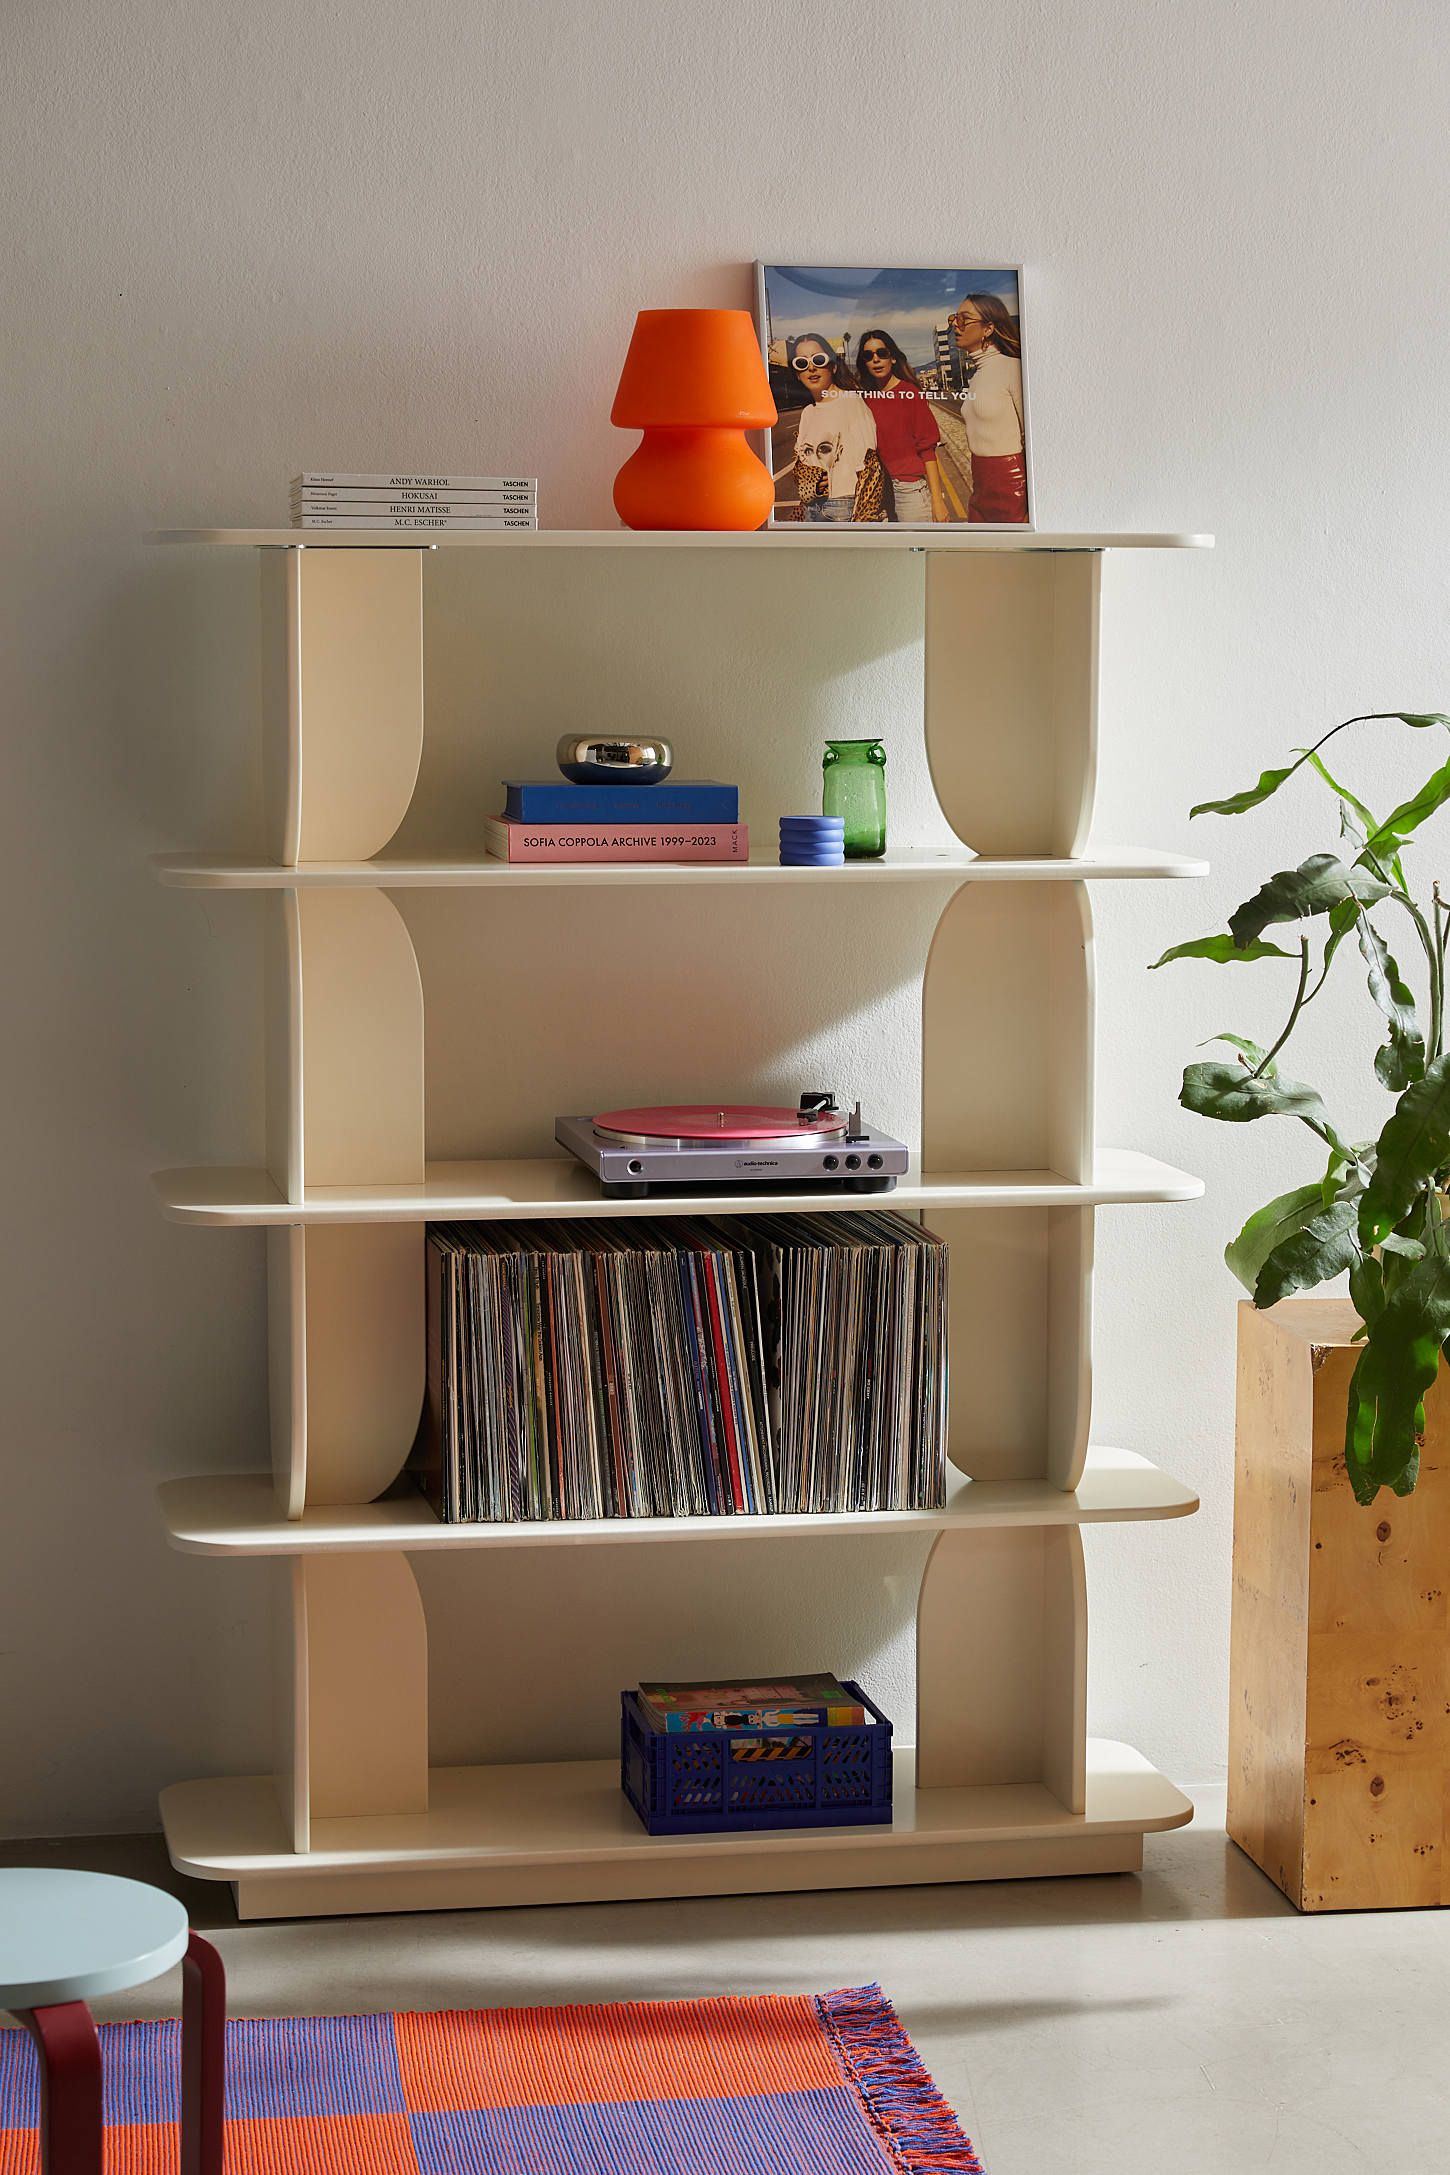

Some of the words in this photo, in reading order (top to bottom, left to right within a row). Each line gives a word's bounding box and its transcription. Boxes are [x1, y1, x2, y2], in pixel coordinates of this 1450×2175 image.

[821, 389, 895, 399] SOMETHING
[898, 391, 915, 399] TO
[918, 391, 948, 400] TELL
[951, 391, 977, 400] YOU
[414, 478, 450, 486] WARHOL
[401, 492, 438, 500] HOKUSAI
[390, 505, 415, 513] HENRI
[417, 506, 451, 514] MATISSE
[523, 837, 556, 847] SOFIA
[558, 837, 609, 847] COPPOLA
[611, 837, 657, 847] ARCHIVE
